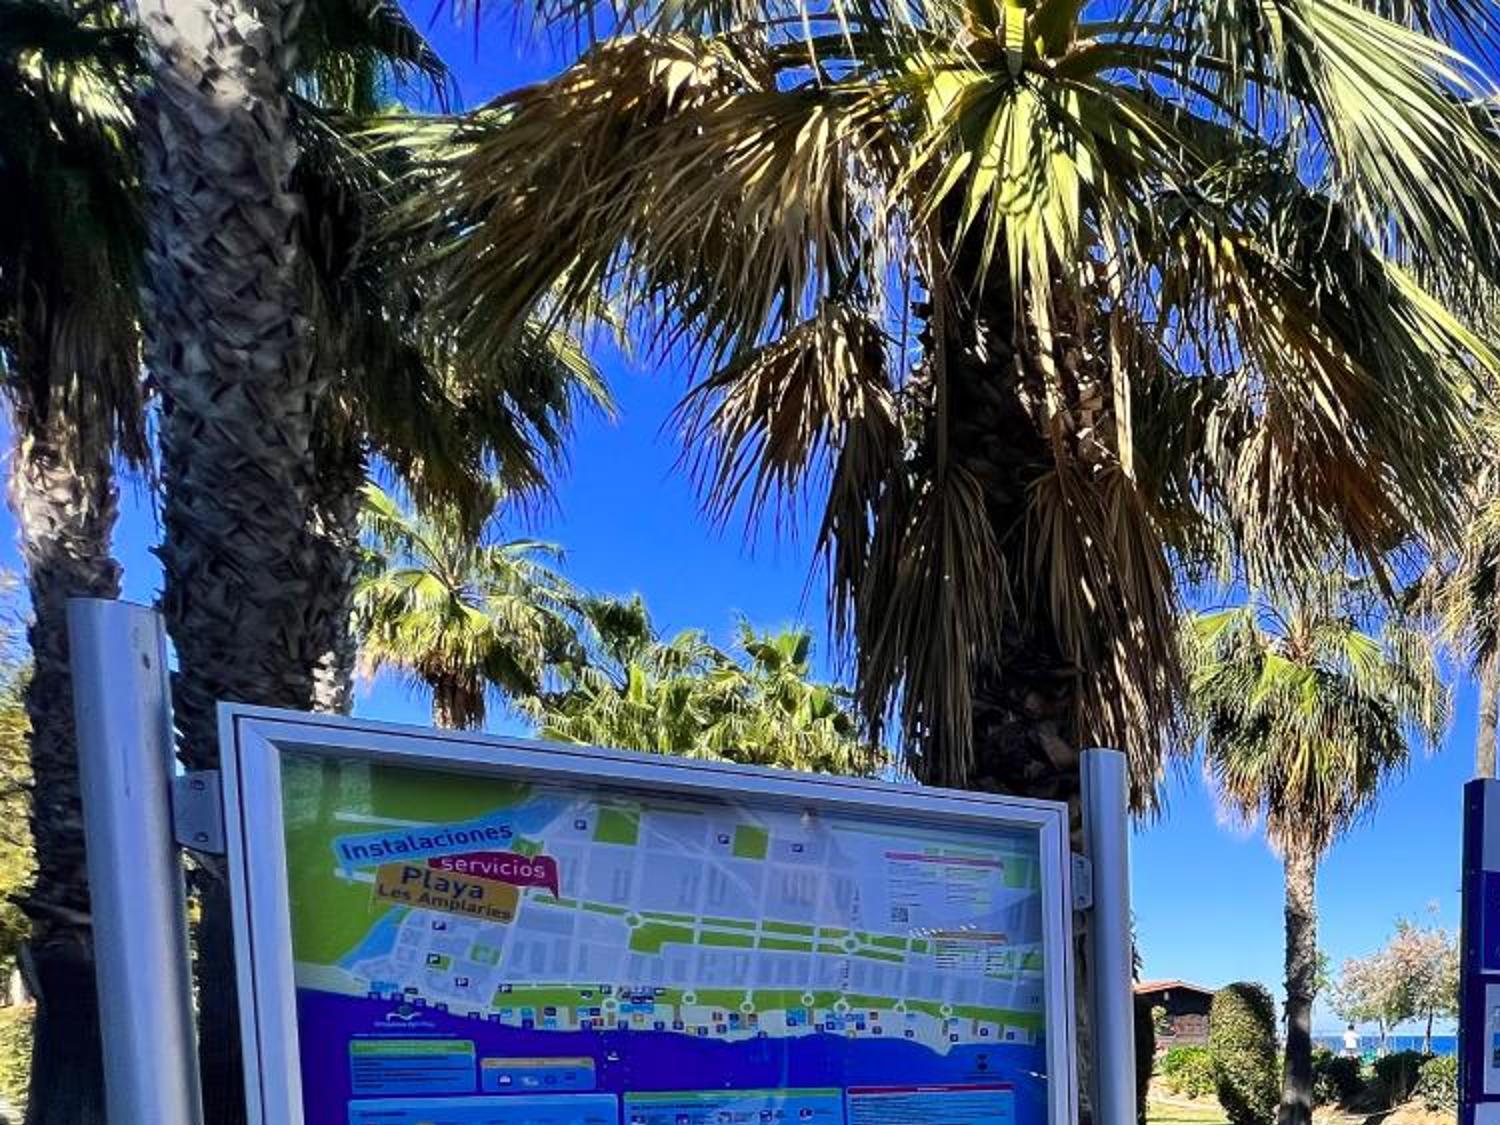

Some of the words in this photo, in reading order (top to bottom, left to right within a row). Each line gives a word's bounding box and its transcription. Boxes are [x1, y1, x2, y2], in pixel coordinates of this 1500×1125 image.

[341, 825, 513, 860] Instalaciones
[402, 866, 484, 899] Playa
[440, 857, 545, 879] servicios
[378, 883, 411, 901] Les
[416, 892, 513, 920] Amplaries
